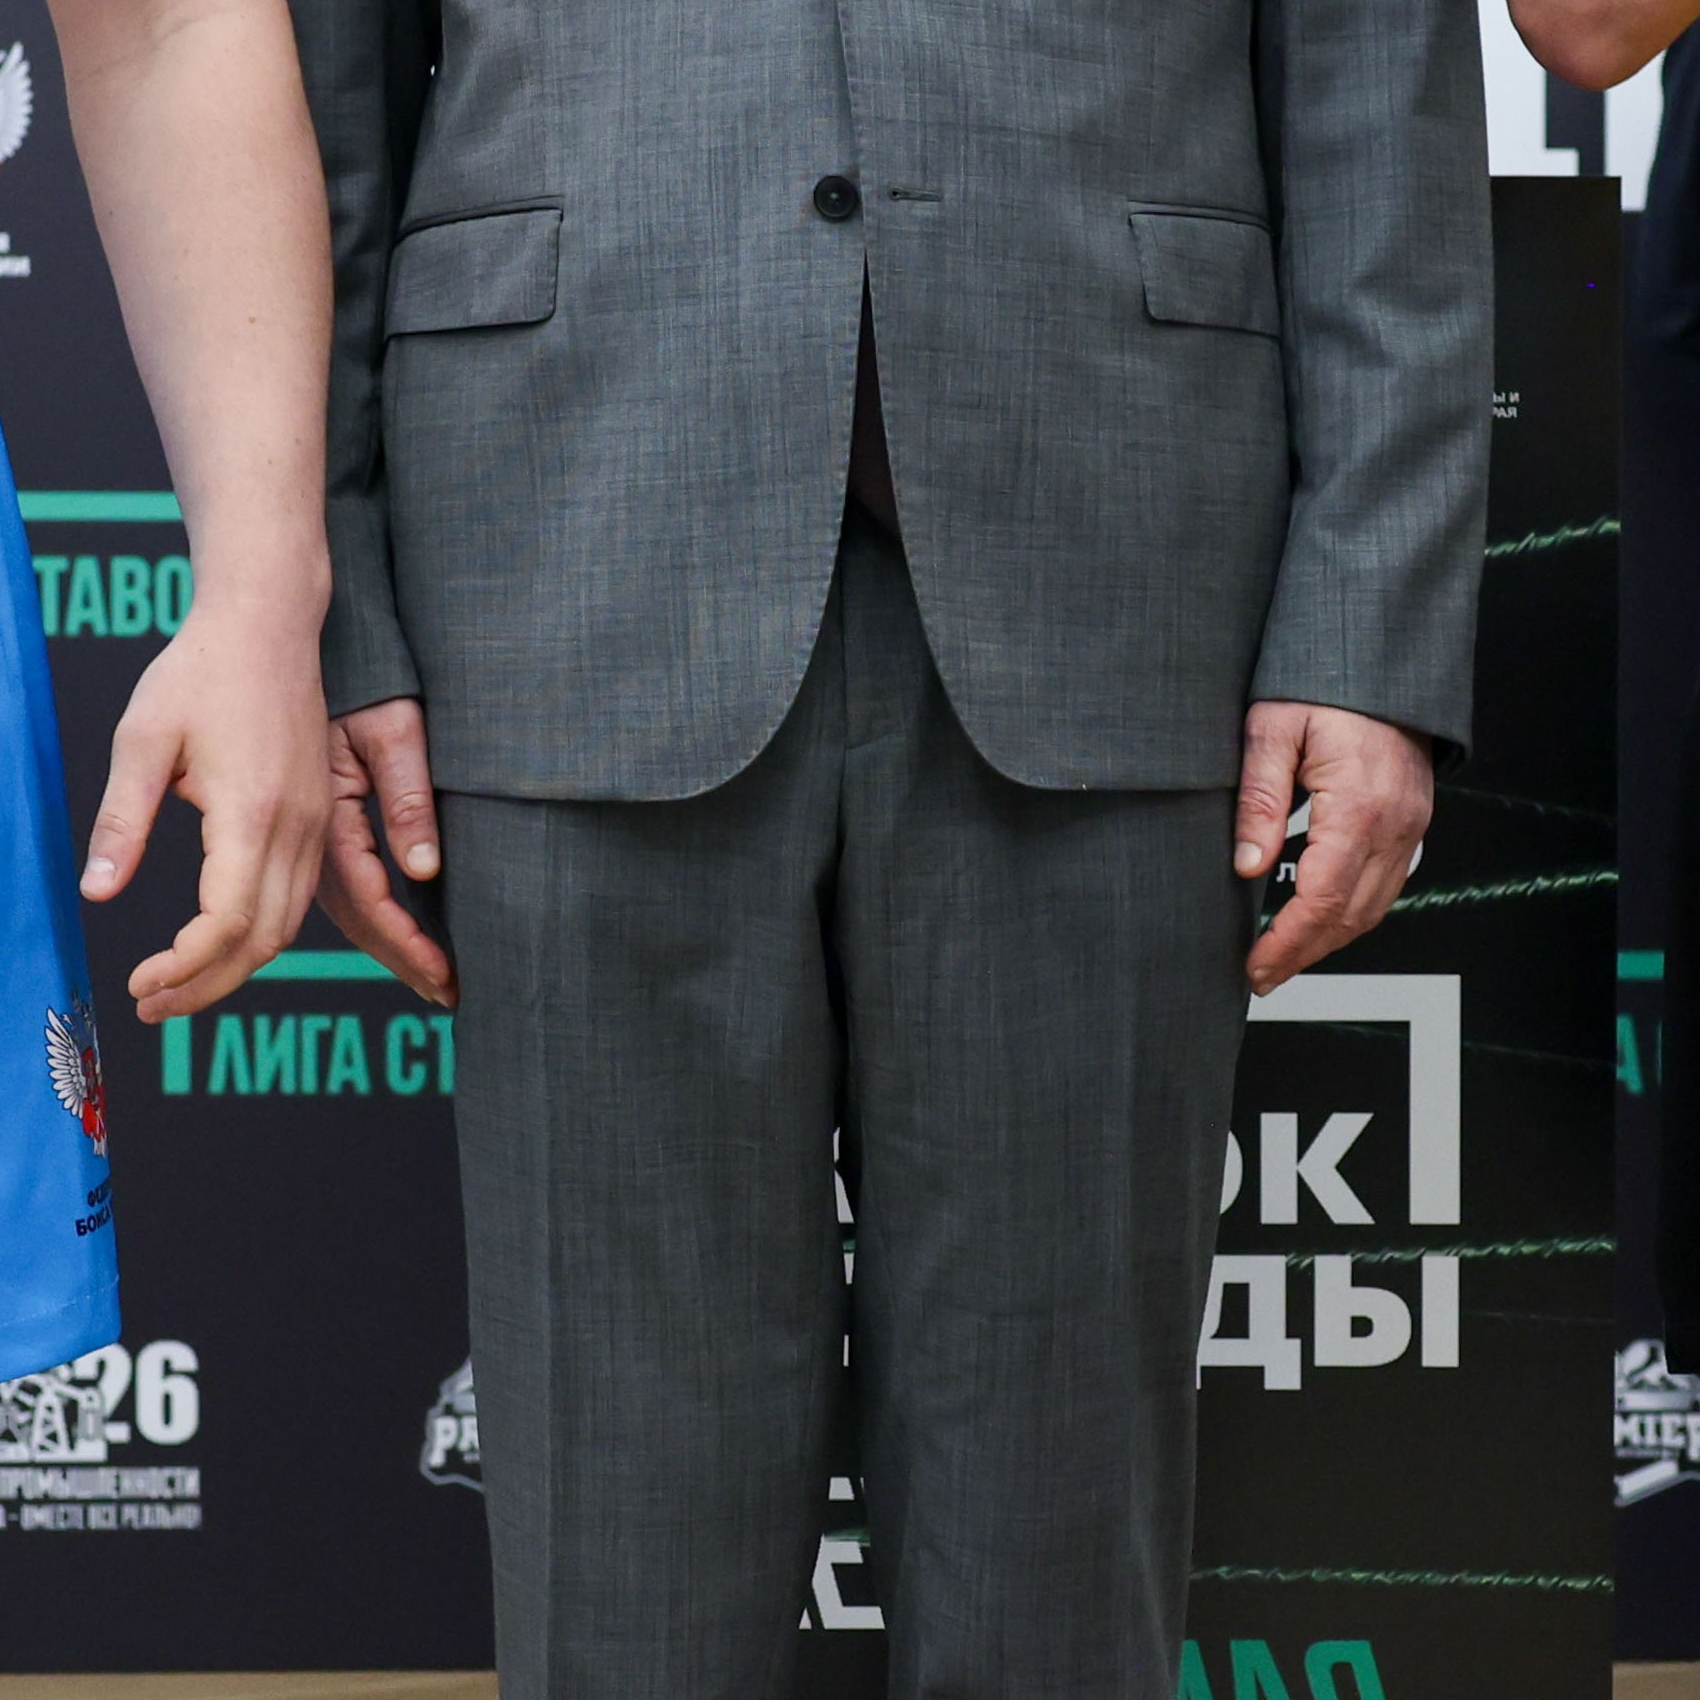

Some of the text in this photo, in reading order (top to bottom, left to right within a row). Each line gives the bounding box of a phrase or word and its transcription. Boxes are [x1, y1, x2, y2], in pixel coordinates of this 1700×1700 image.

[32, 555, 195, 637] ТАВО
[208, 1013, 455, 1095] ЛИГА СТ
[74, 1339, 198, 1445] 26
